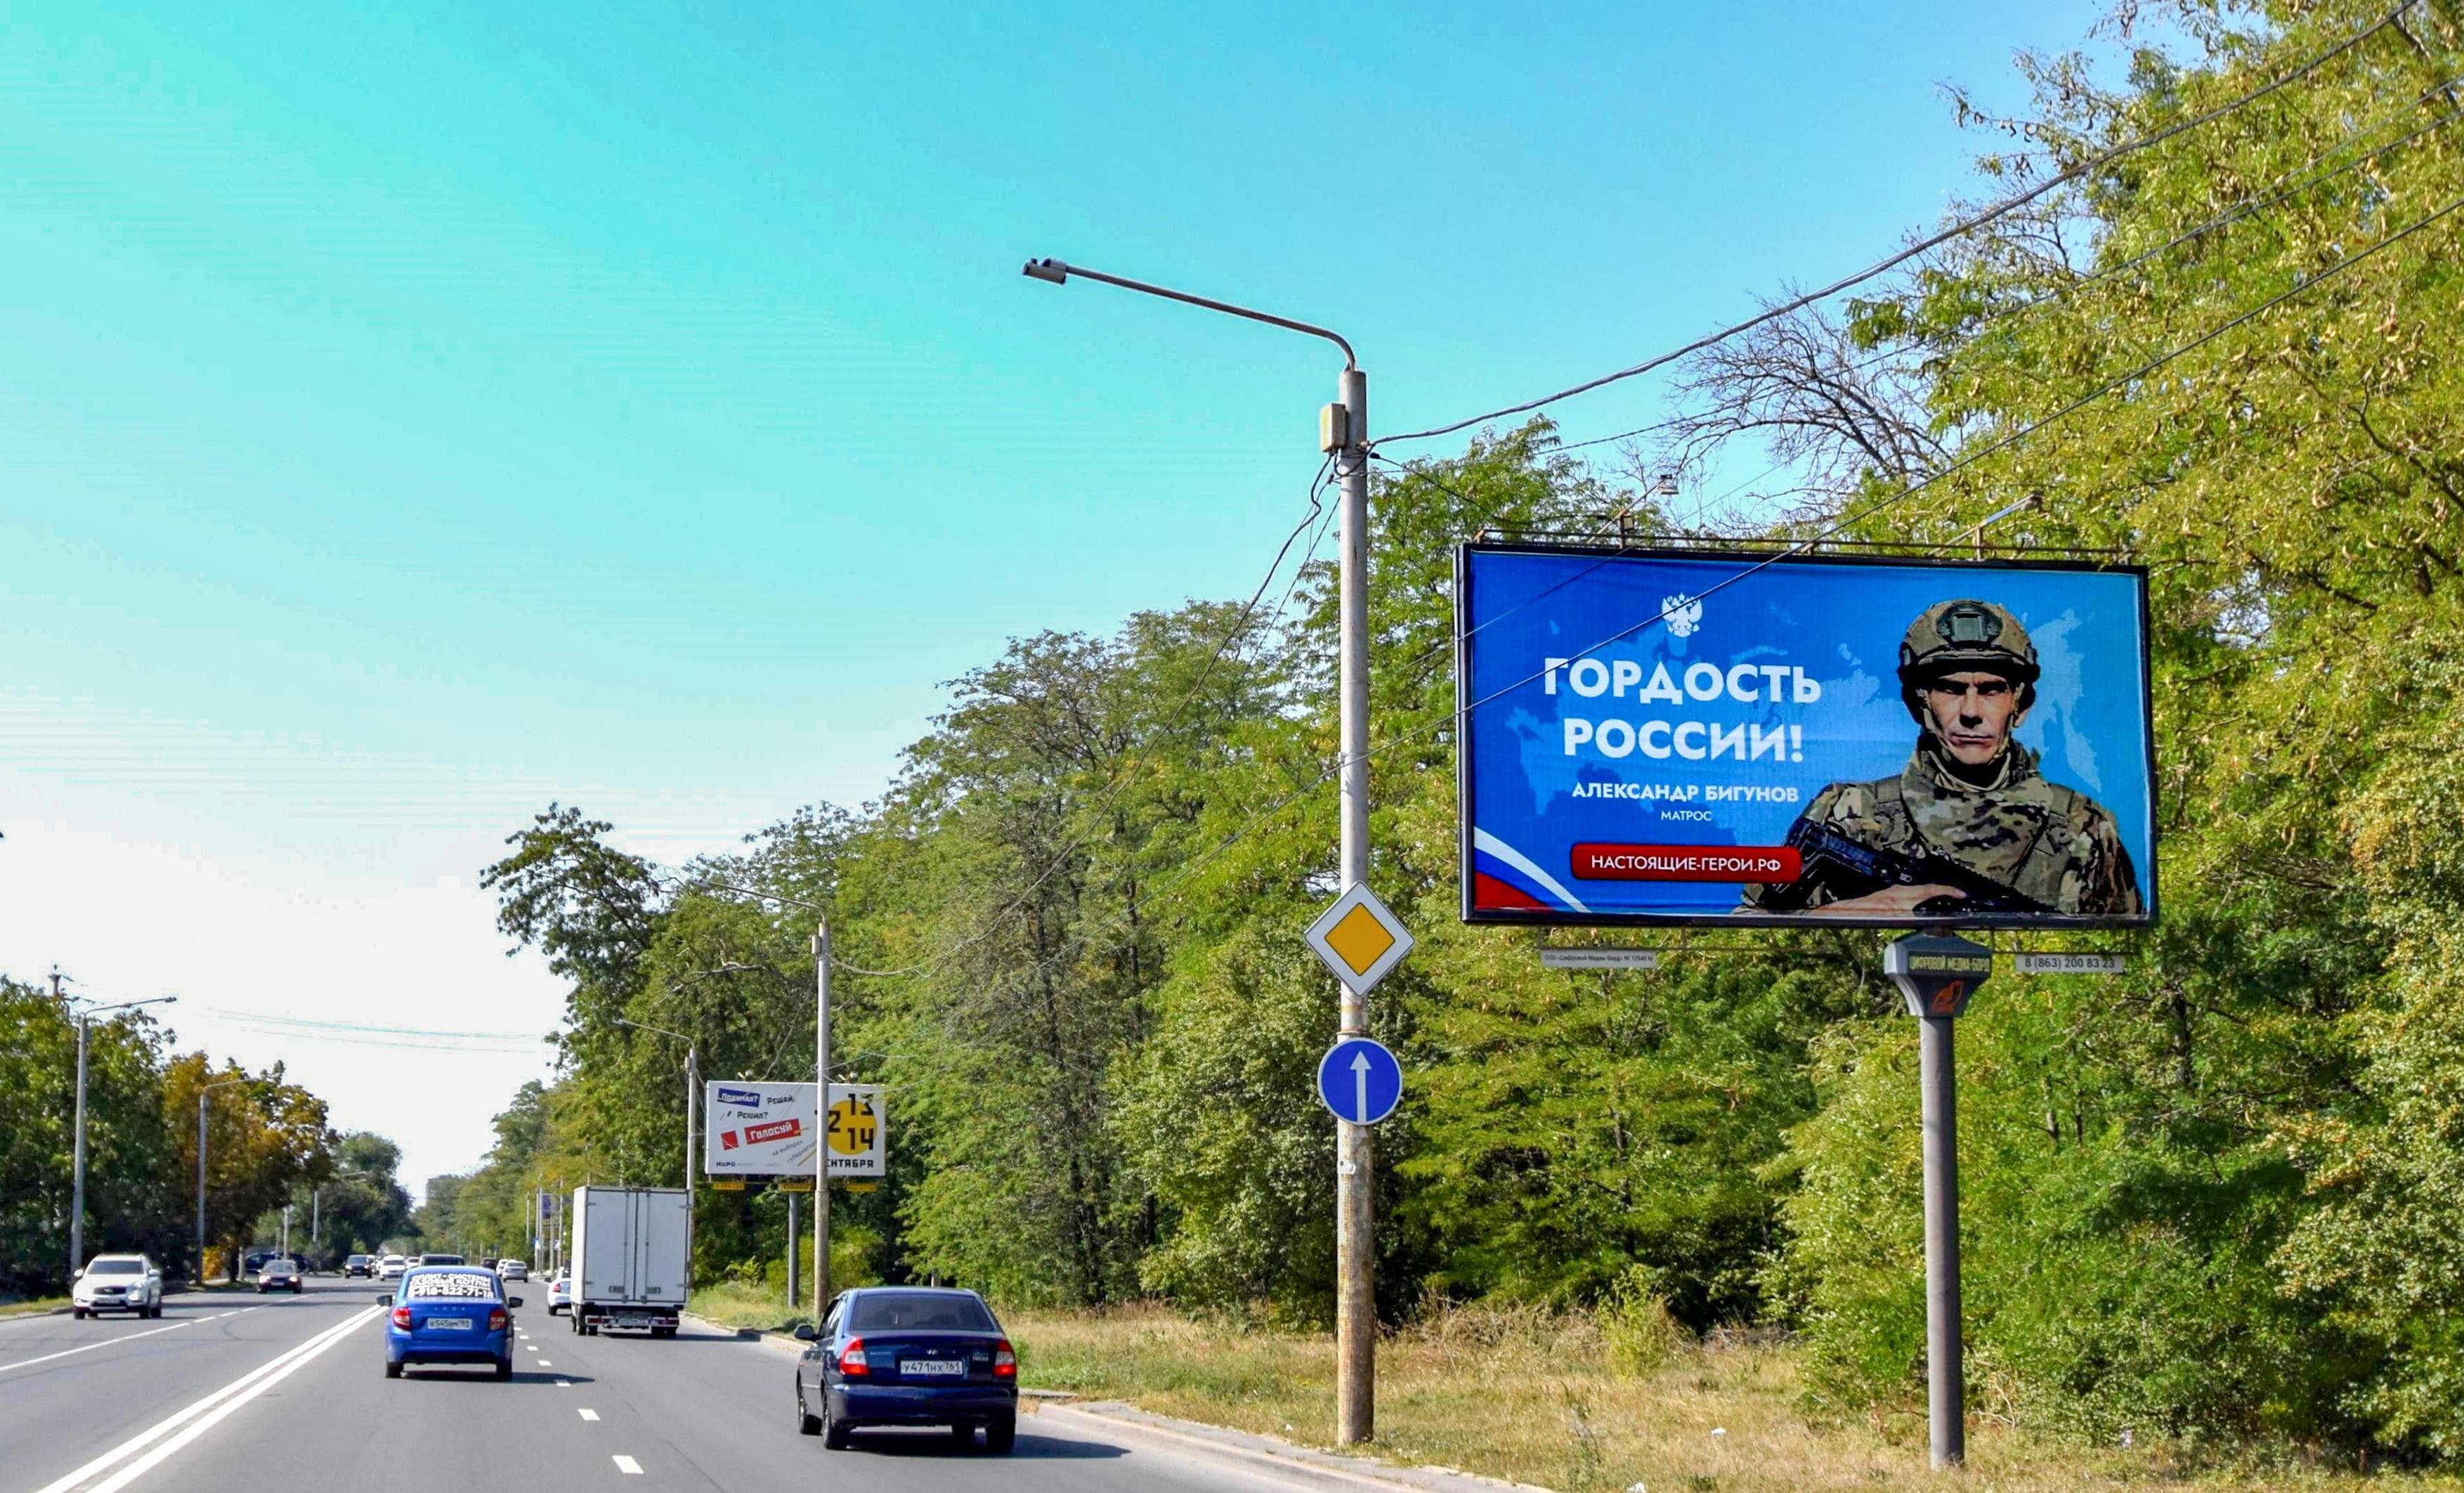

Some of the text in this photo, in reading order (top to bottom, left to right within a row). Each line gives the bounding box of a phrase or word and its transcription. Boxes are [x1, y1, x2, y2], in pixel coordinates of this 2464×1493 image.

[1544, 658, 1821, 705] ГОРДОСТЬ
[1564, 718, 1803, 763] РОССИИ!
[1572, 783, 1799, 802] АЛЕКСАНДР БИГУНОВ
[1661, 810, 1712, 821] МАТРОС
[1591, 855, 1781, 873] НАСТОЯЩИЕ-ГЕРОИ.РФ
[2024, 957, 2115, 970] 8 (863) 200 83 23
[815, 1110, 840, 1133] 2
[847, 1128, 873, 1150] 14
